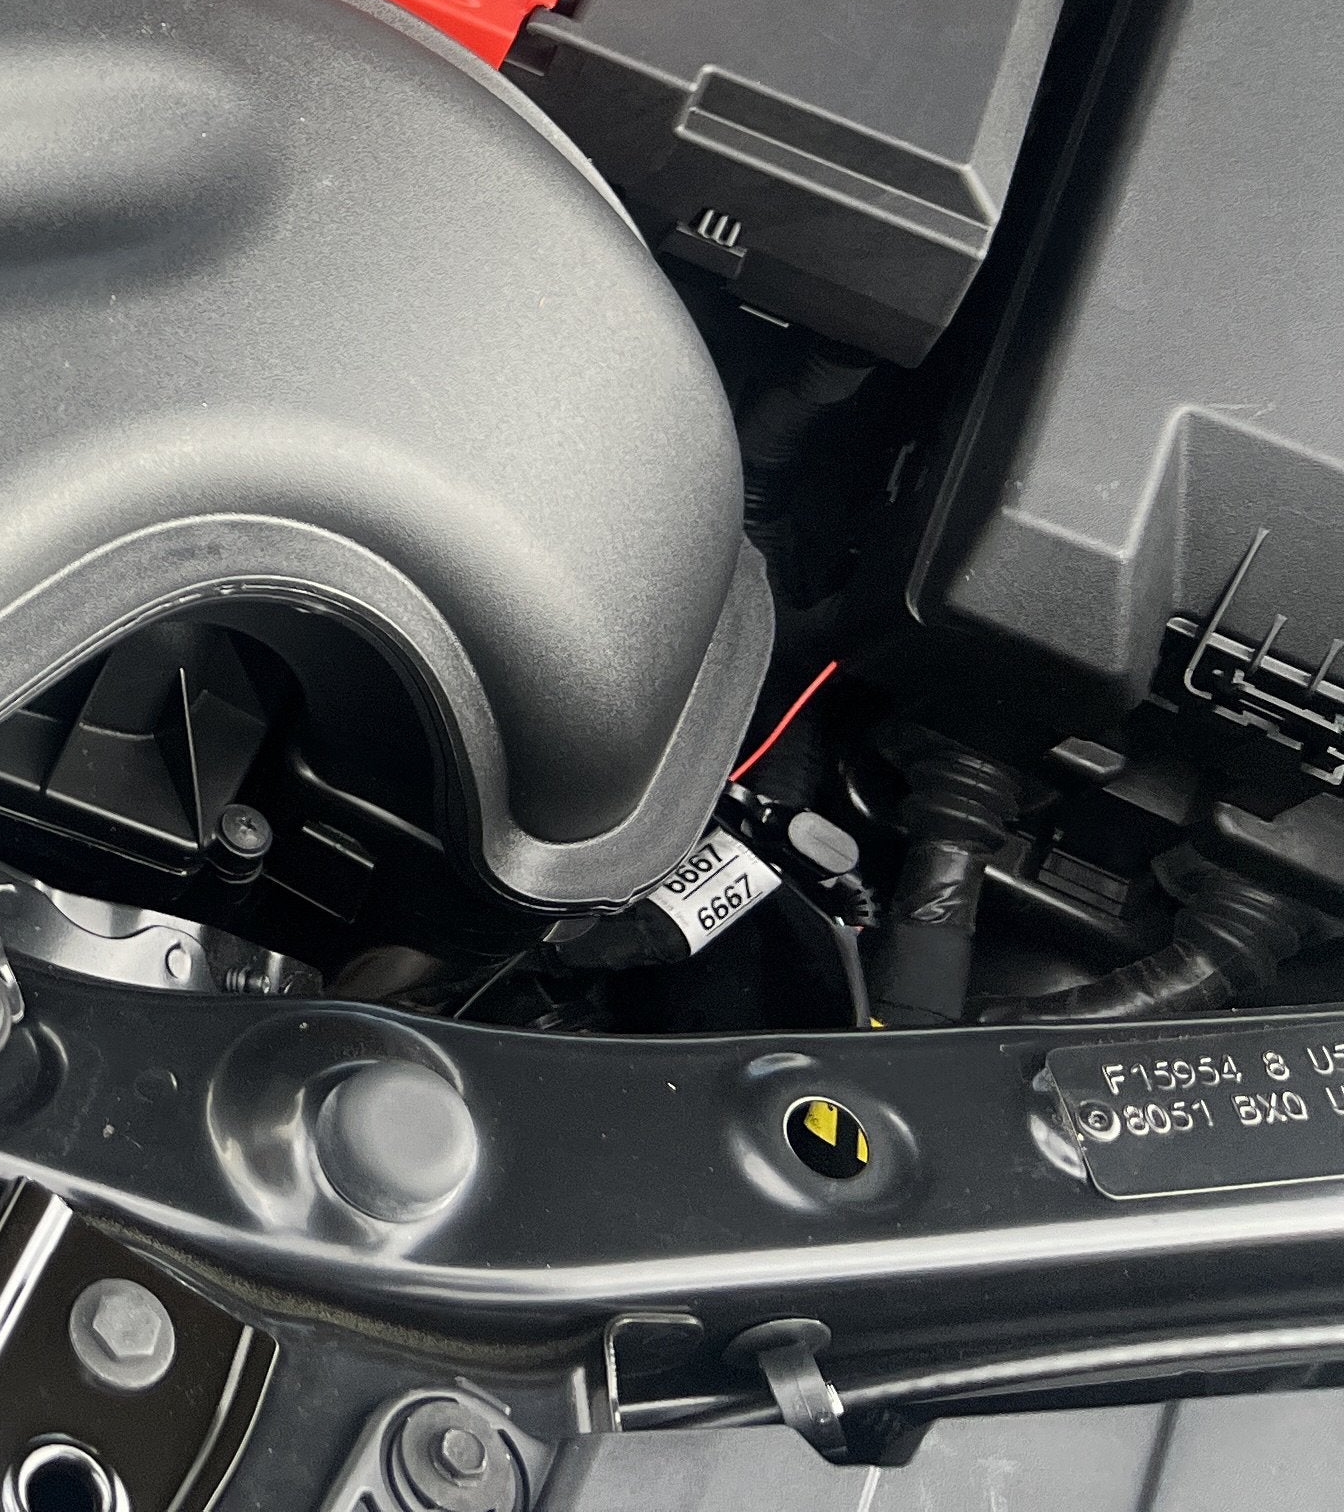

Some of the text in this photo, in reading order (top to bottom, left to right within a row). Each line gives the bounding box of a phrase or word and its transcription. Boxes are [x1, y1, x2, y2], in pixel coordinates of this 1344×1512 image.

[663, 843, 723, 893] 6667
[697, 872, 752, 931] 6667
[1123, 1099, 1214, 1136] 8051
